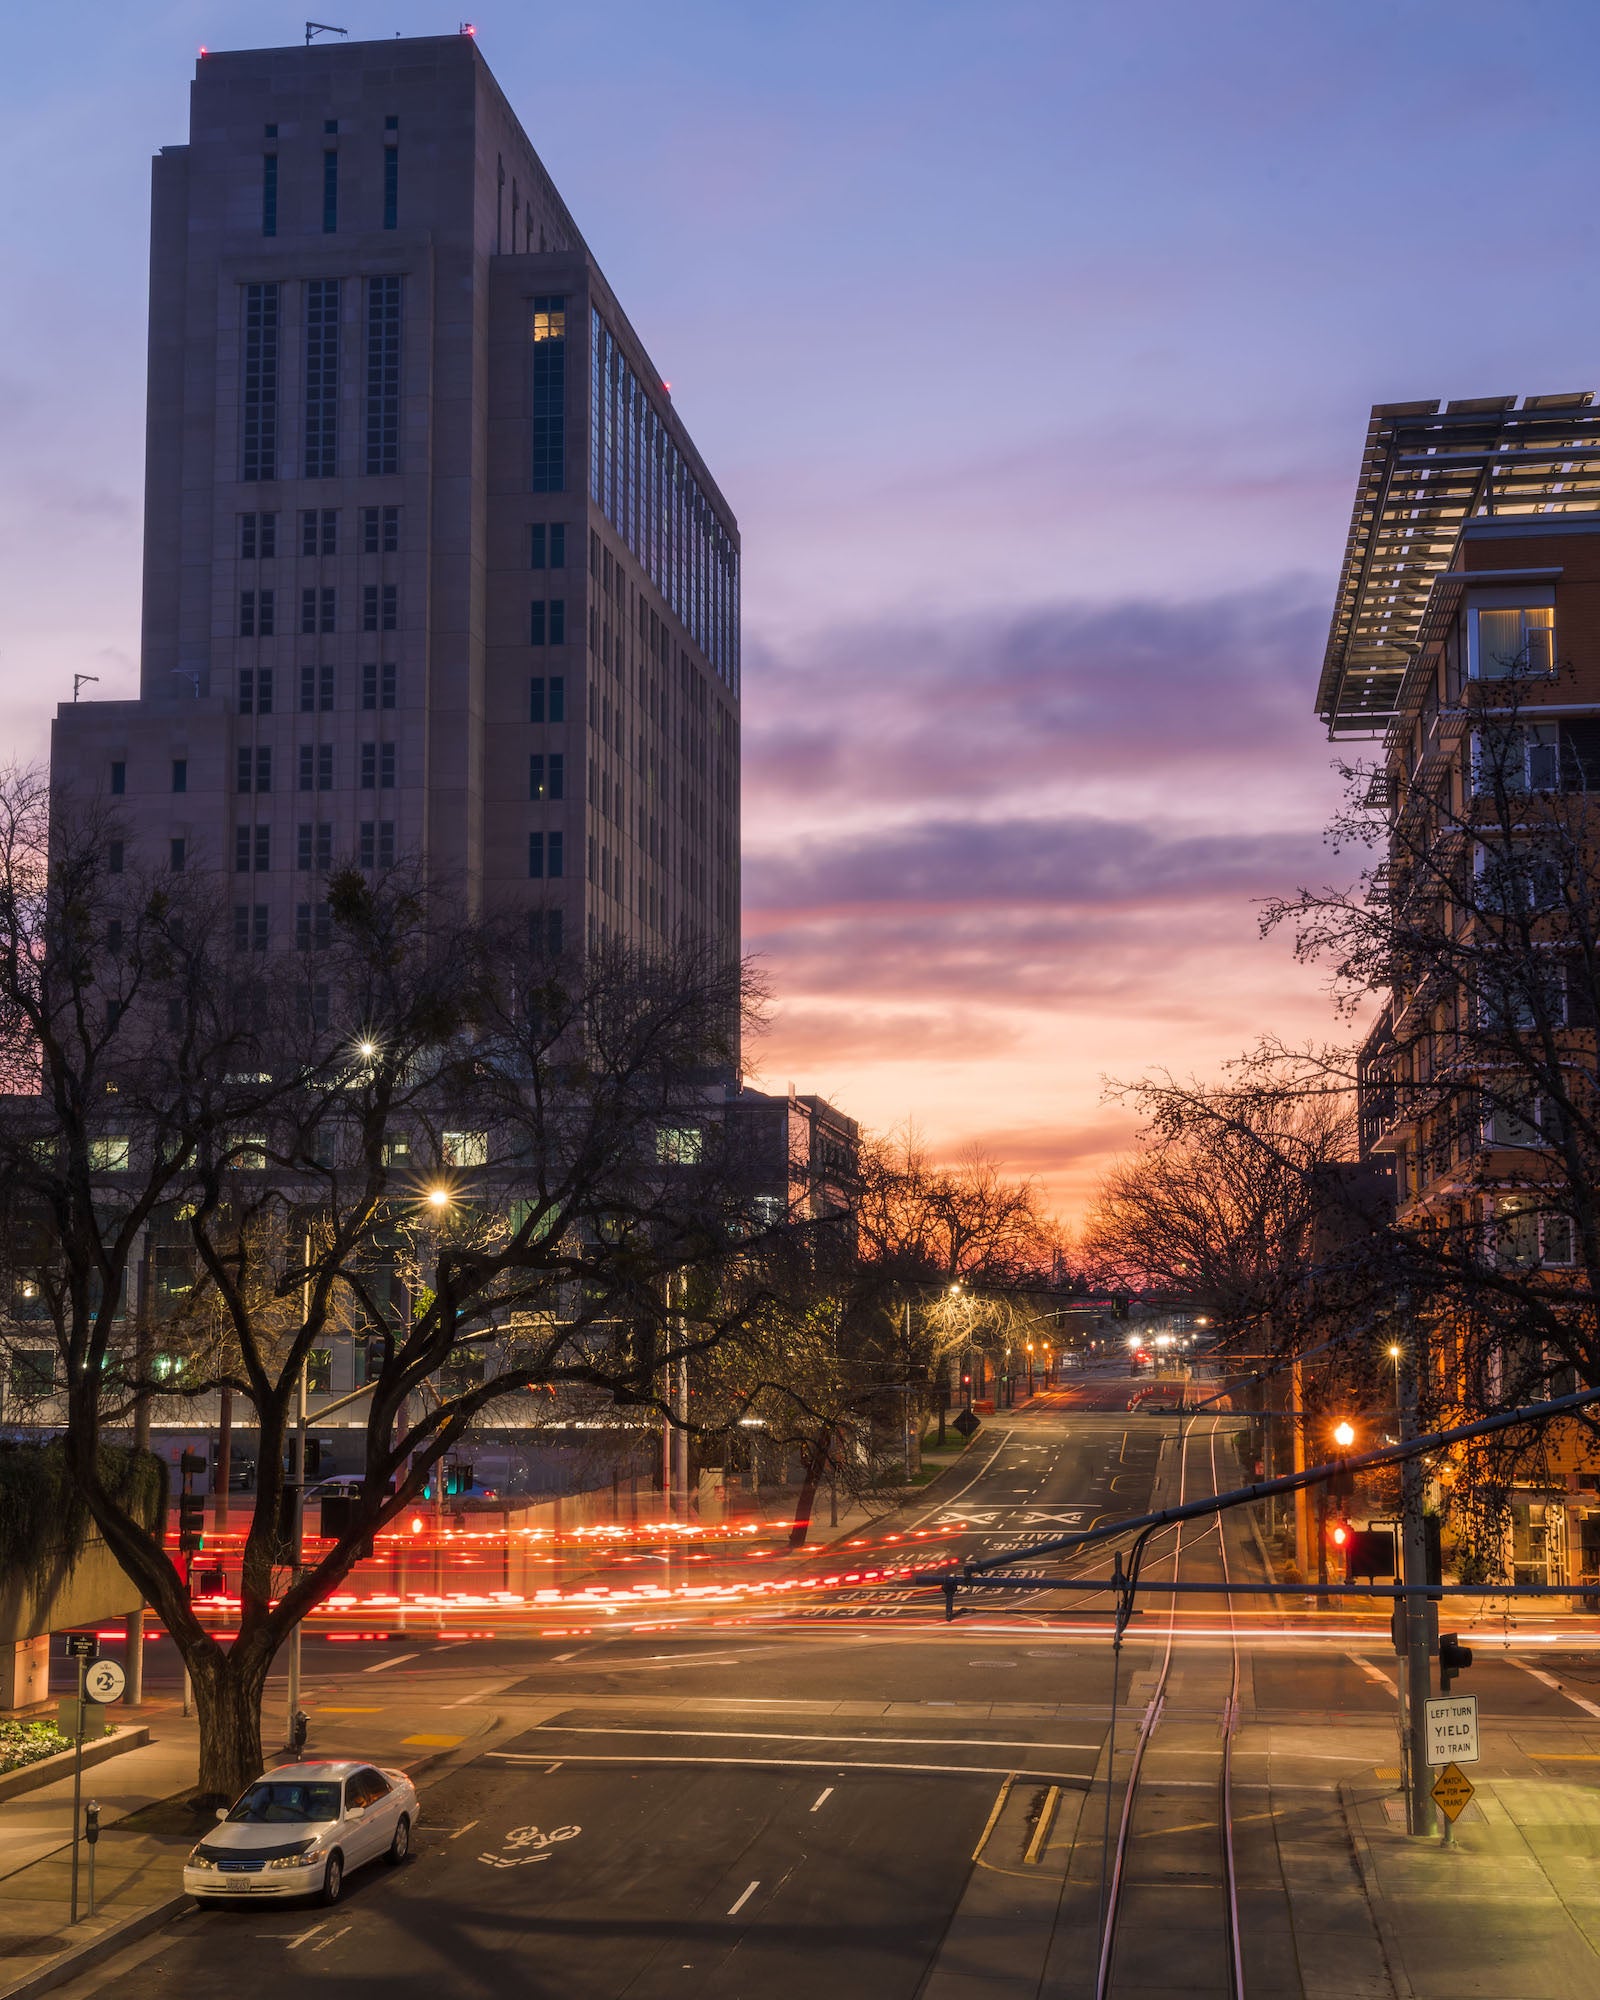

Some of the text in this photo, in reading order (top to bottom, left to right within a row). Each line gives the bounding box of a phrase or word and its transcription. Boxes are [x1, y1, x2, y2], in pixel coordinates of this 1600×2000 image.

[1012, 1533, 1065, 1541] WAIT
[988, 1543, 1042, 1551] ERE
[890, 1552, 947, 1561] WAIT
[837, 1591, 914, 1601] KEEP
[801, 1606, 903, 1616] CLEAR
[1430, 1706, 1472, 1719] LEFT TURN
[1435, 1724, 1470, 1737] YIELD
[1435, 1743, 1471, 1755] TO TRAIN
[1443, 1777, 1462, 1785] WATCH
[1447, 1788, 1458, 1796] FOR
